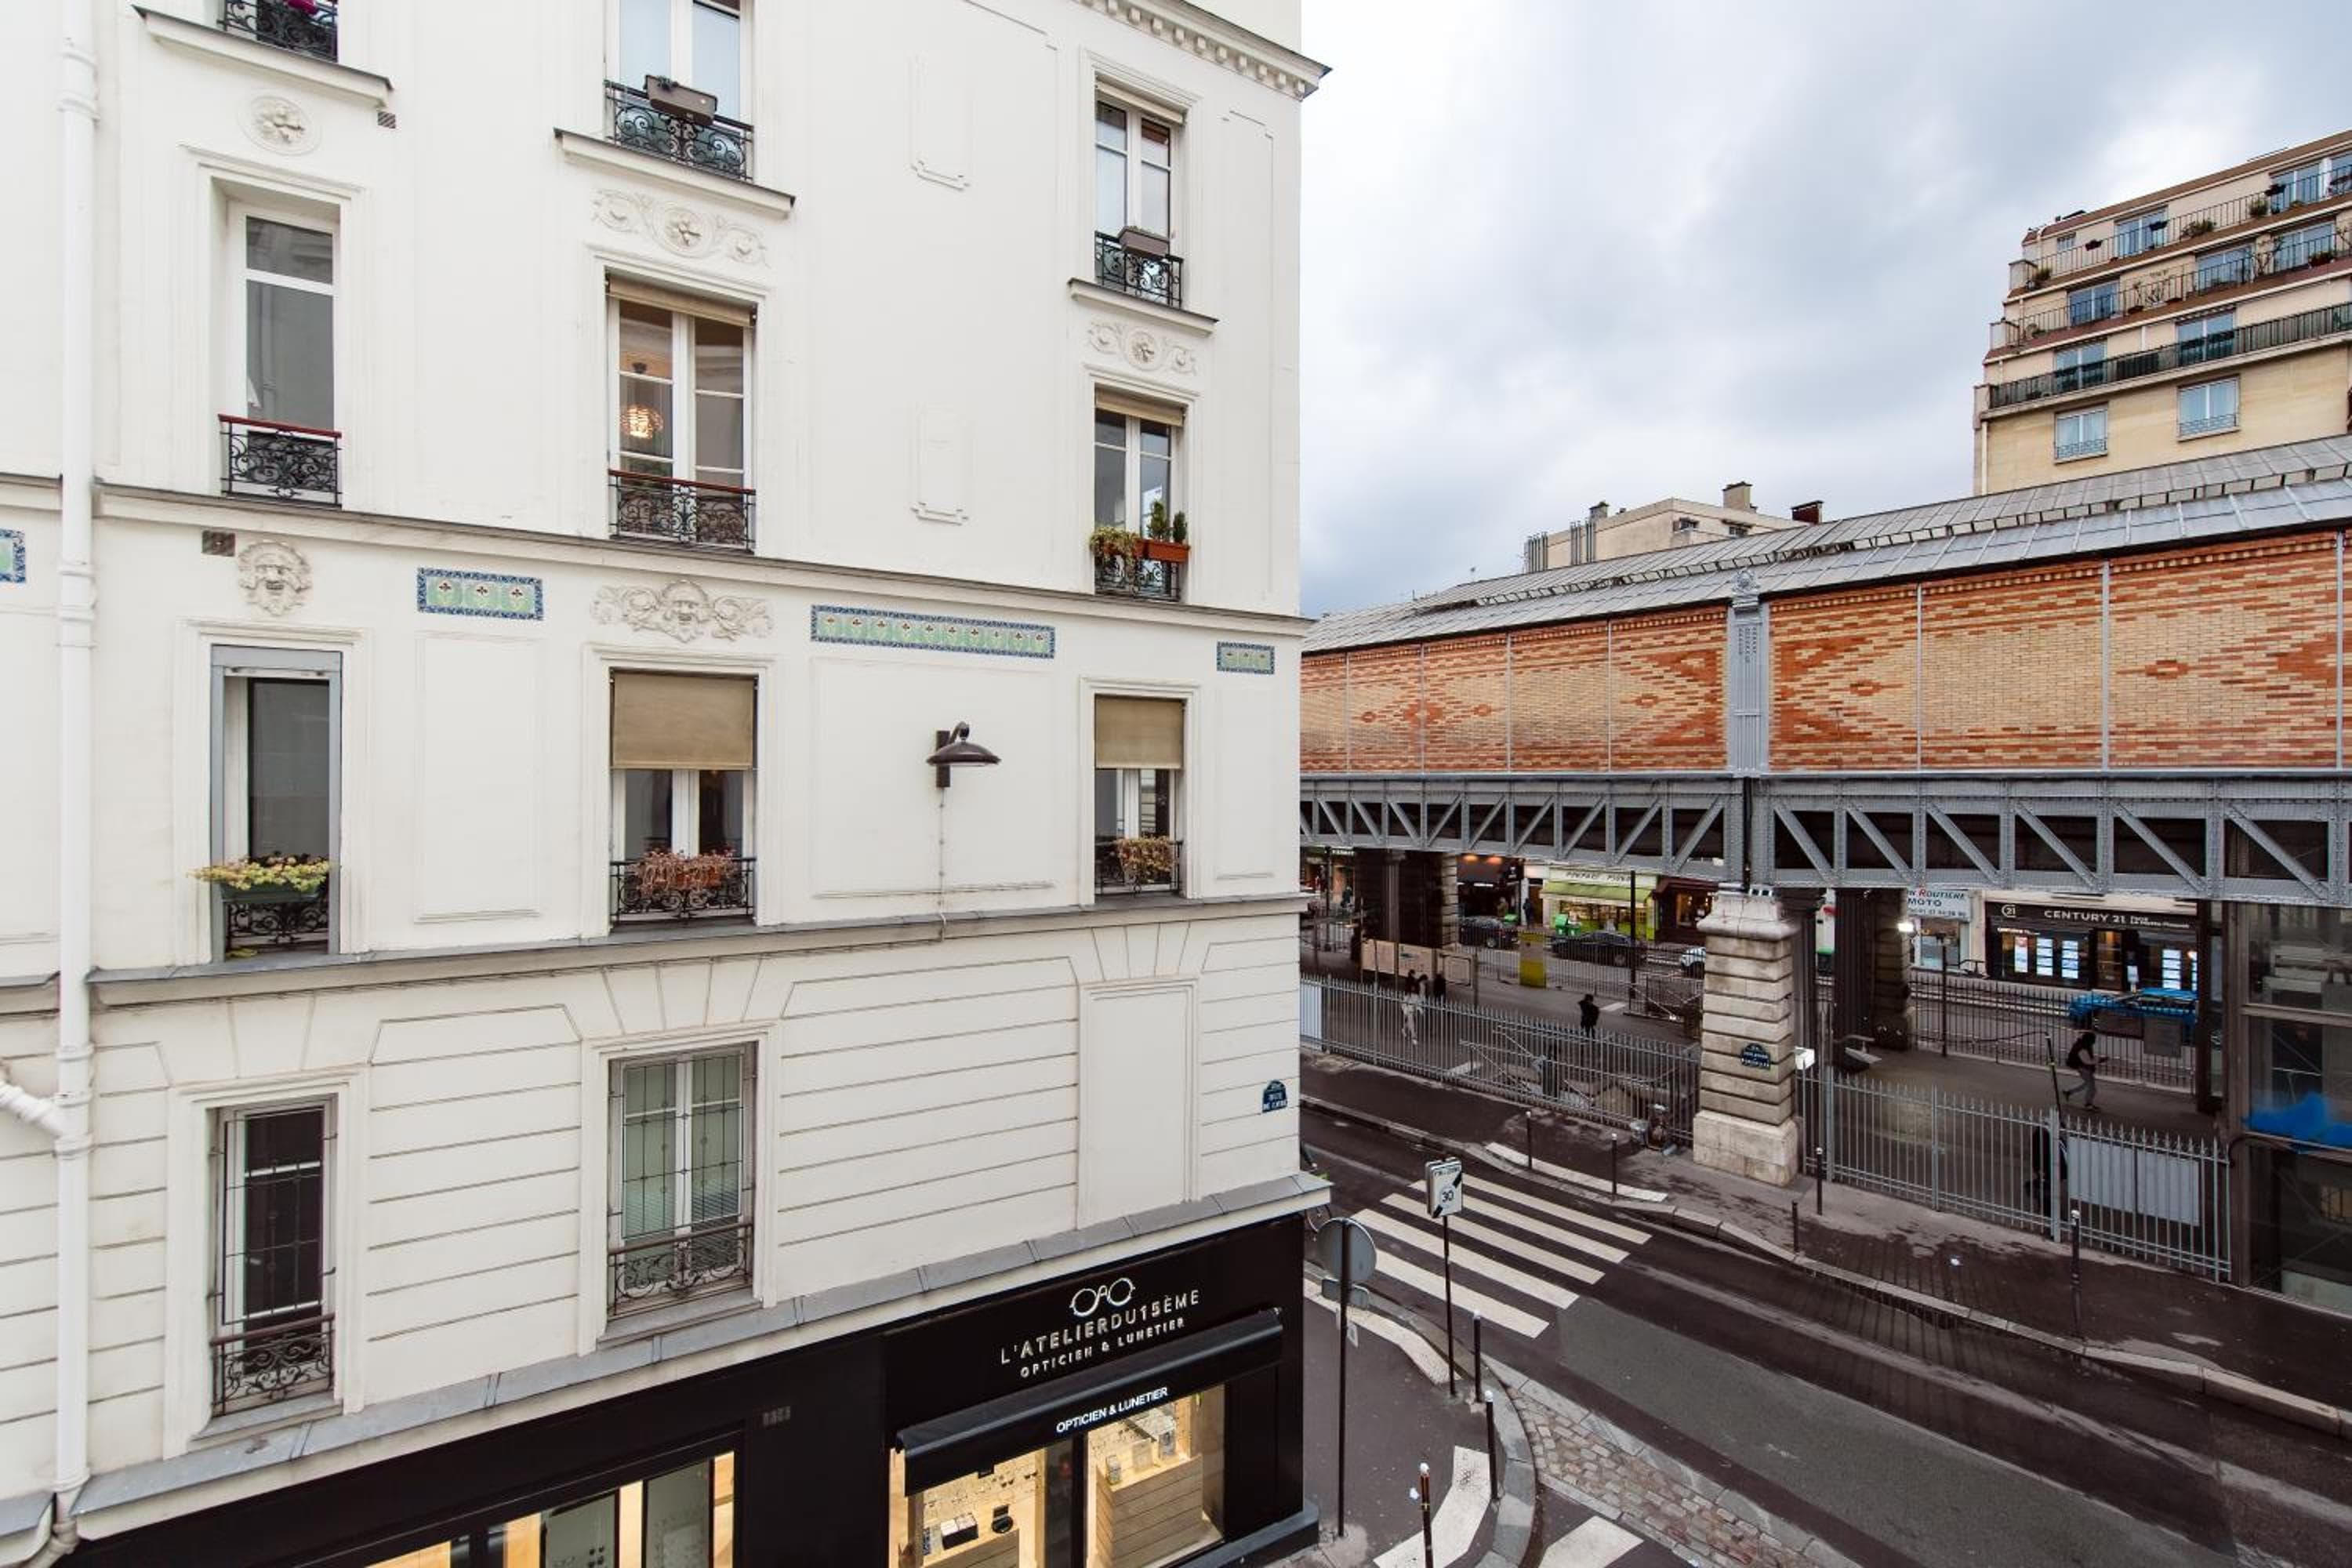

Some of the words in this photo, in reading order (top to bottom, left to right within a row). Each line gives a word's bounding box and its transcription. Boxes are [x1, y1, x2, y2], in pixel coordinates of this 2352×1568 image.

[1907, 898, 1942, 907] MOTO
[2044, 909, 2108, 923] CENTURY
[2112, 915, 2126, 924] 21
[1442, 1189, 1454, 1203] 30
[1021, 1346, 1093, 1378] OPTICIEN
[1102, 1341, 1110, 1353] &
[1117, 1317, 1185, 1347] LUNETIER
[1055, 1412, 1107, 1433] OPTICIEN
[1109, 1406, 1117, 1415] &
[1118, 1387, 1169, 1413] LUNETIER
